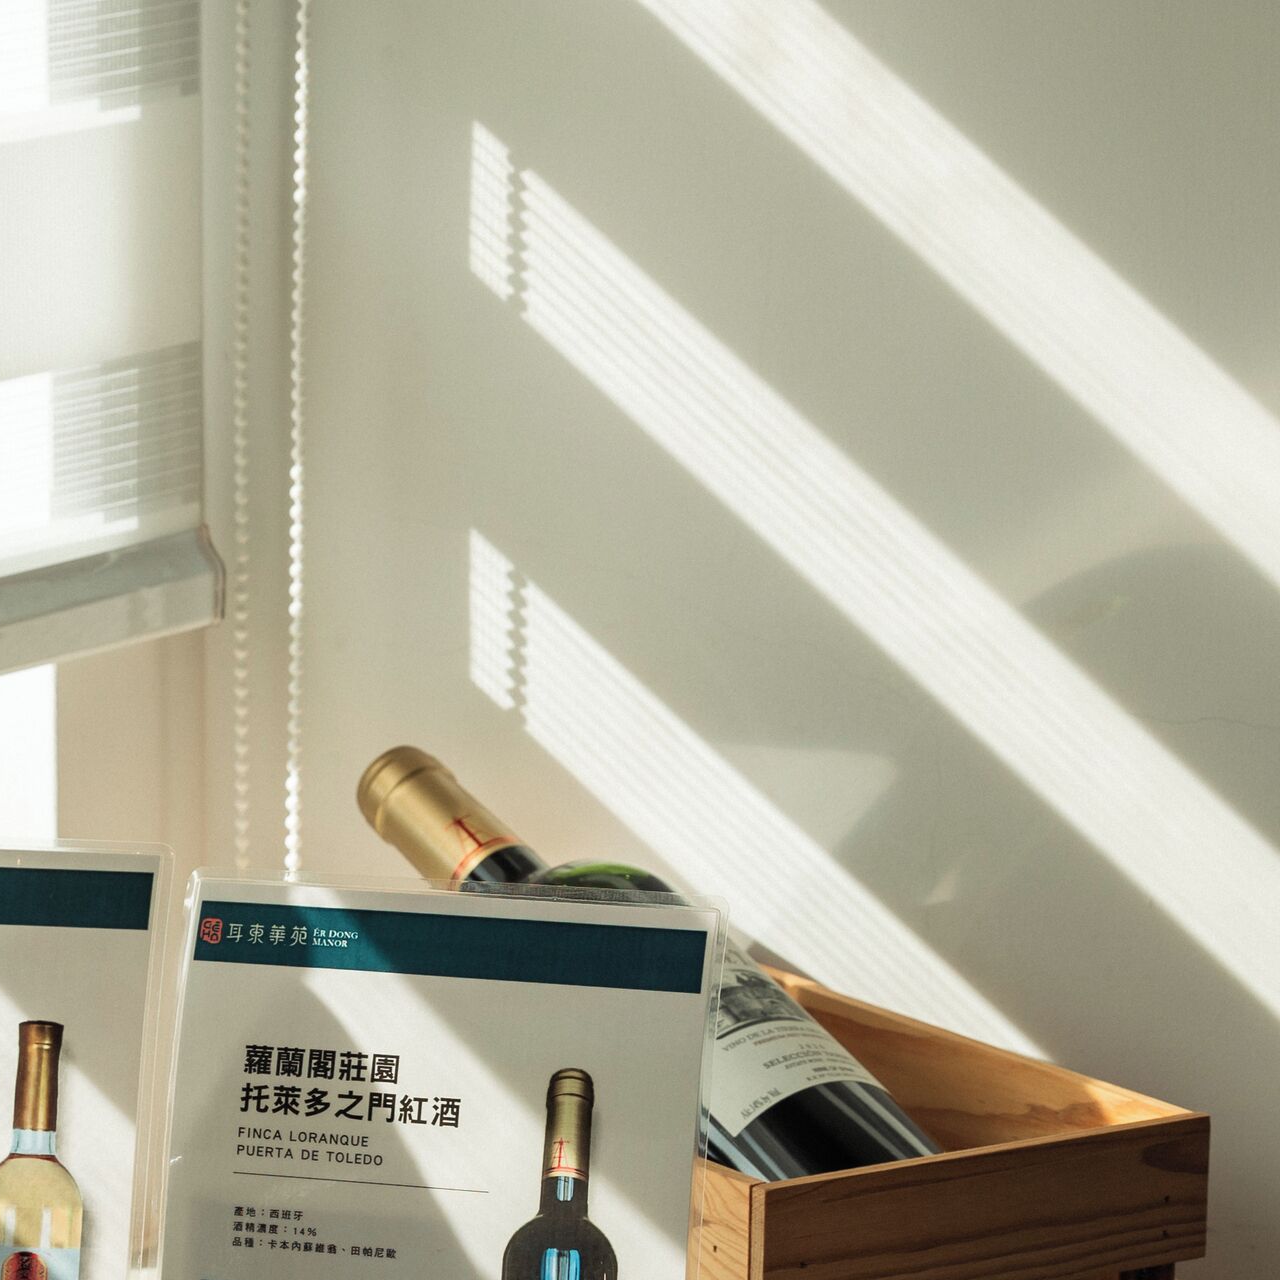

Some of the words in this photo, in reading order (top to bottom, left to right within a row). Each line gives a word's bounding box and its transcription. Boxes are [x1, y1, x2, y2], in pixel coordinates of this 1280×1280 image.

[312, 938, 347, 947] MANOR
[328, 929, 358, 940] DONG
[244, 1044, 400, 1085] 蘿蘭閣莊園
[240, 1082, 461, 1128] 托萊多之門紅酒
[238, 1127, 282, 1141] FINCA
[290, 1130, 369, 1147] LORANQUE
[236, 1145, 293, 1159] PUERTA
[301, 1150, 319, 1161] DE
[326, 1151, 383, 1166] TOLEDO
